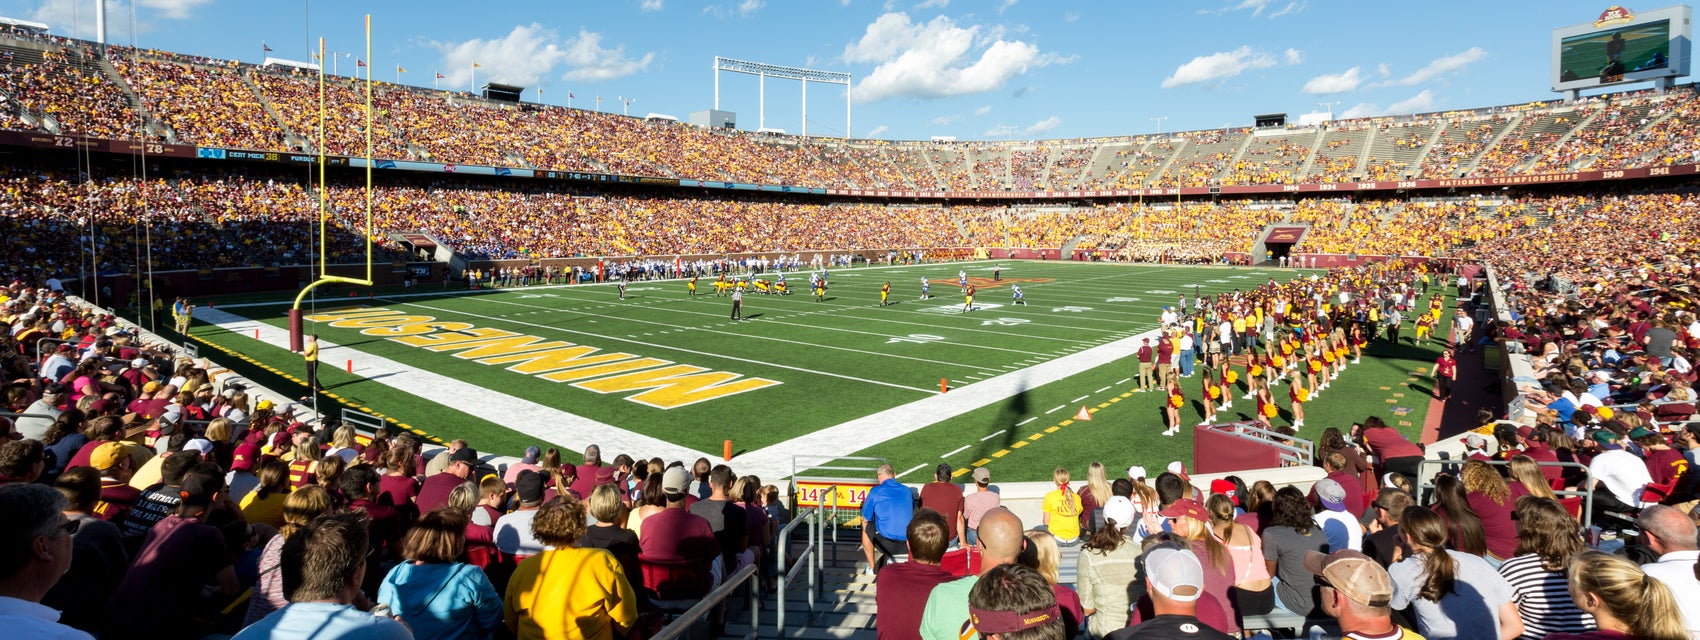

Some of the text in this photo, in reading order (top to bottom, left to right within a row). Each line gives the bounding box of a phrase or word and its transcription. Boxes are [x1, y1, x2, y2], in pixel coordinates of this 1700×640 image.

[54, 136, 73, 147] 72
[146, 144, 163, 154] 78
[265, 153, 278, 161] 38
[1602, 168, 1670, 178] 1940 1941
[1492, 174, 1578, 184] CHAMPIONSHIPS
[281, 304, 784, 410] MINNESOTA
[850, 490, 866, 503] 14
